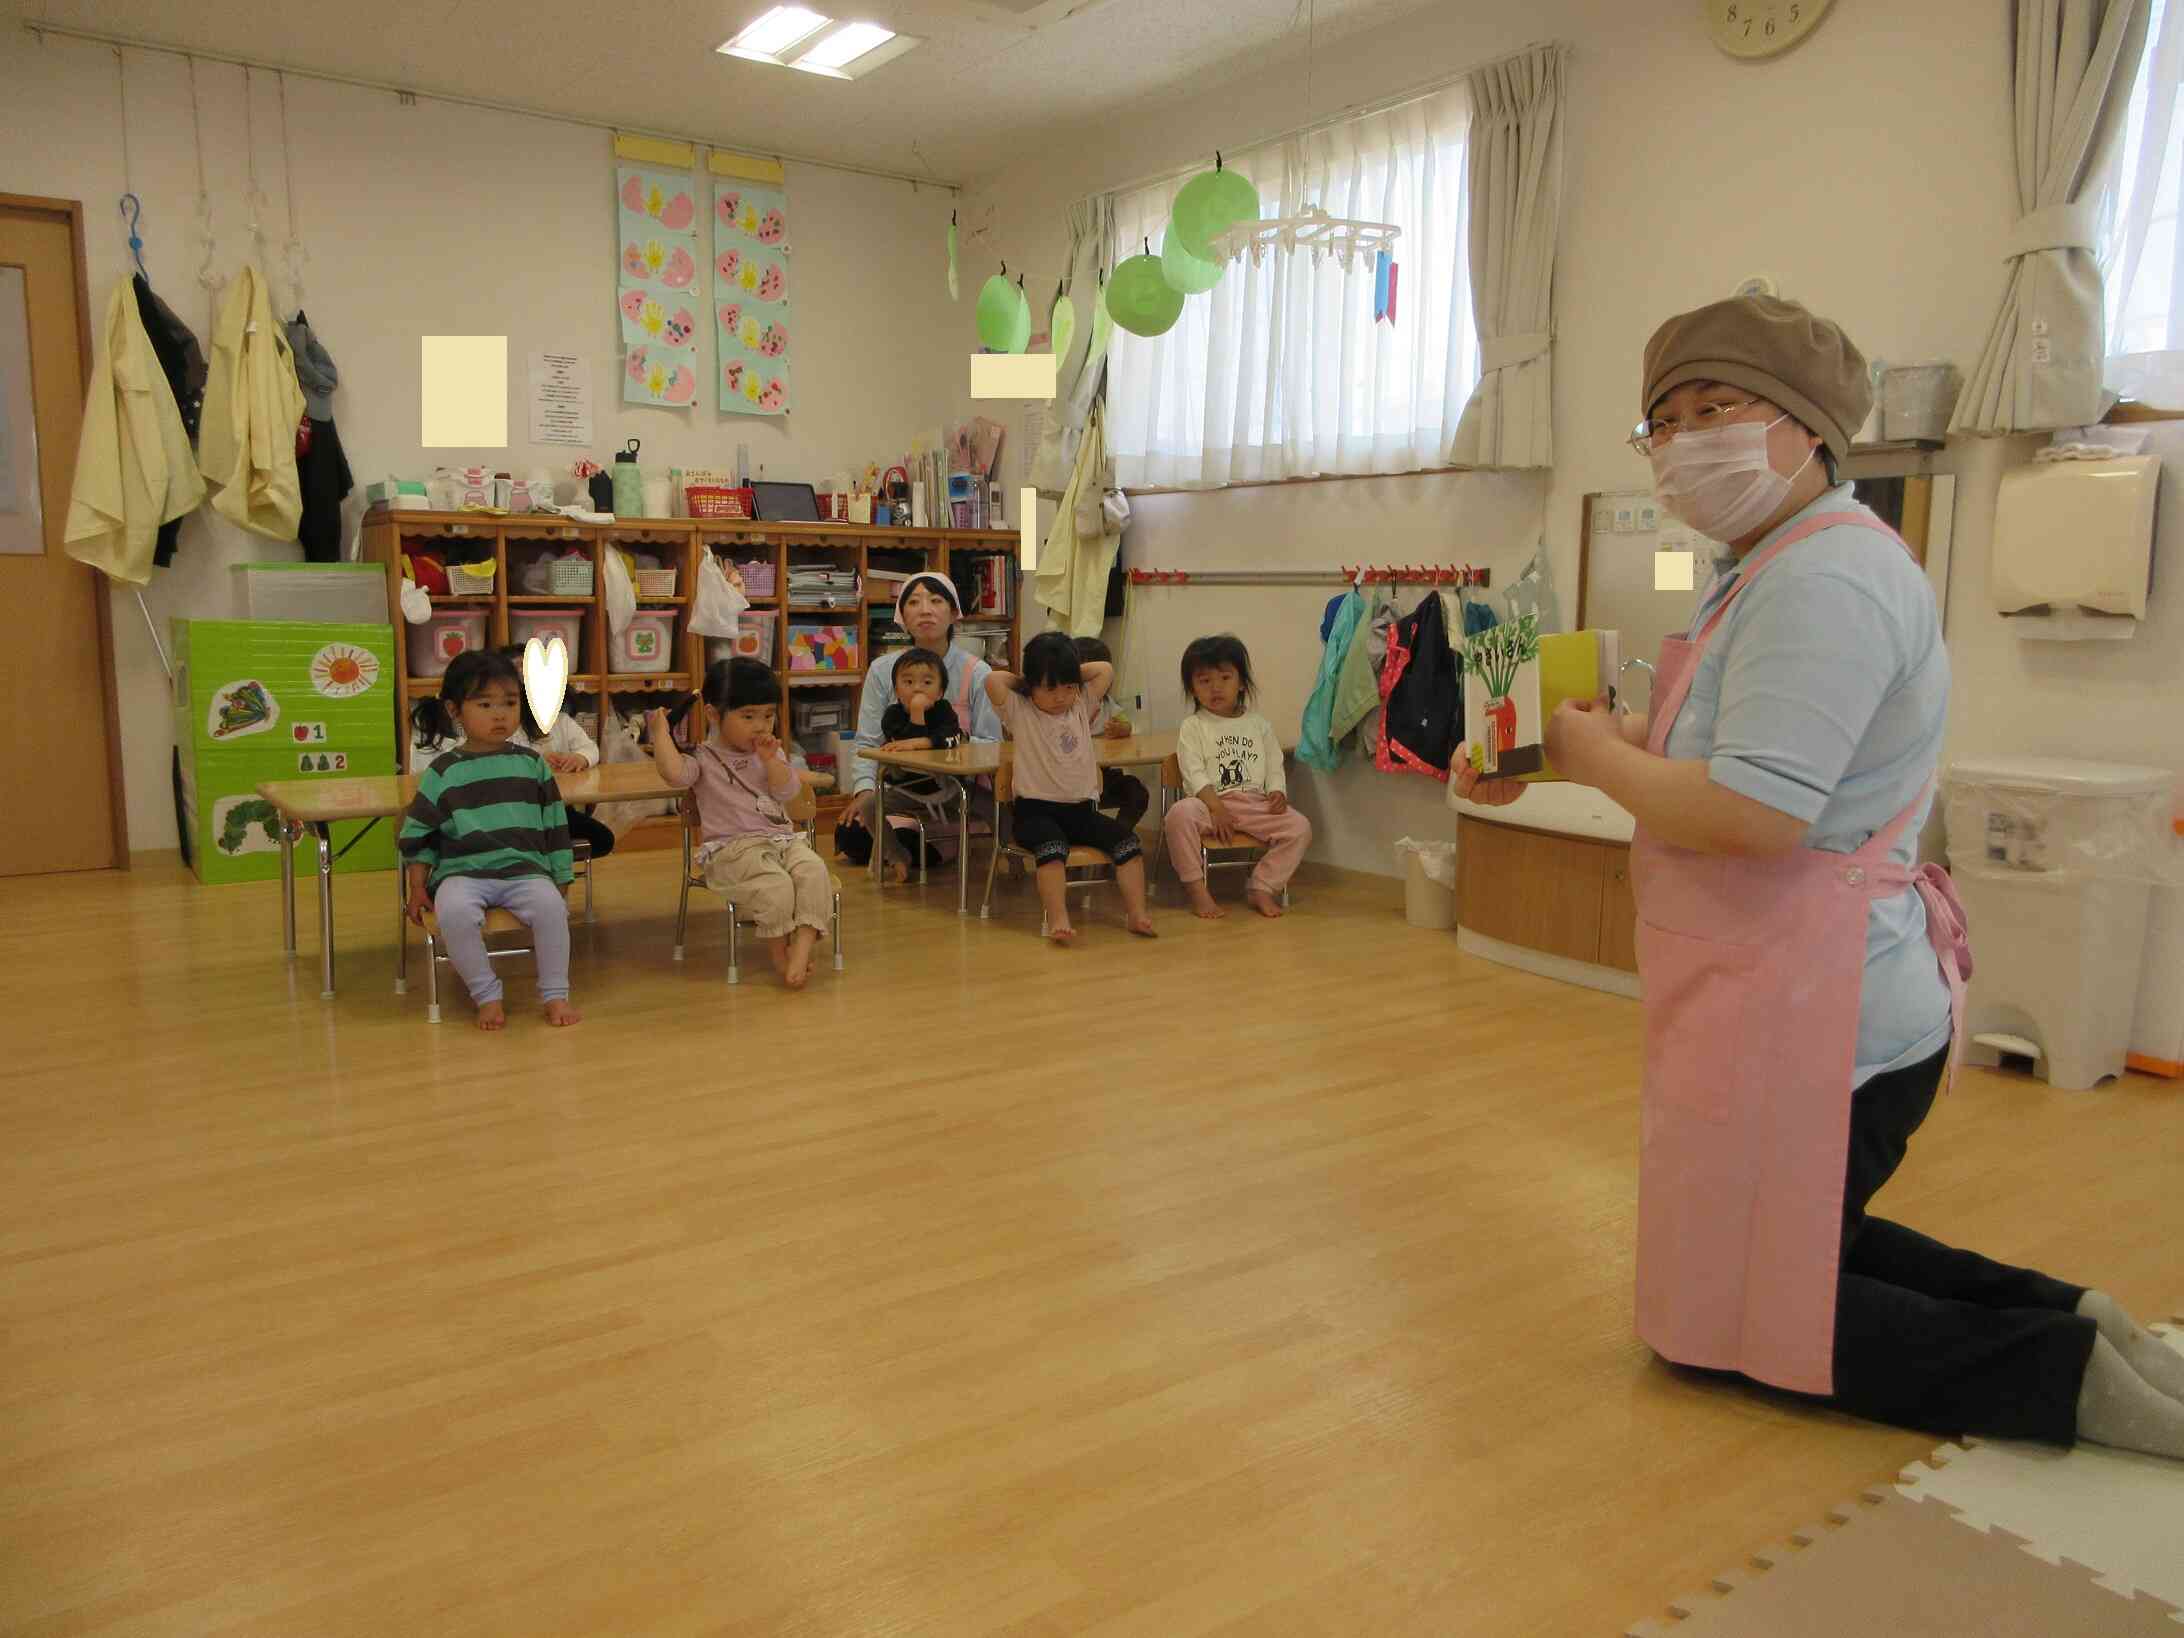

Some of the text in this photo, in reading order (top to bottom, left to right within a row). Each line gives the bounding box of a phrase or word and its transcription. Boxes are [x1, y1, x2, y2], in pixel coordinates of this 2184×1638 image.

[1727, 3, 1737, 23] 8
[1790, 3, 1800, 23] 5
[1743, 18, 1753, 37] 7
[1764, 18, 1775, 36] 6
[313, 724, 324, 739] 1
[1242, 736, 1254, 748] DO
[335, 754, 345, 769] 2
